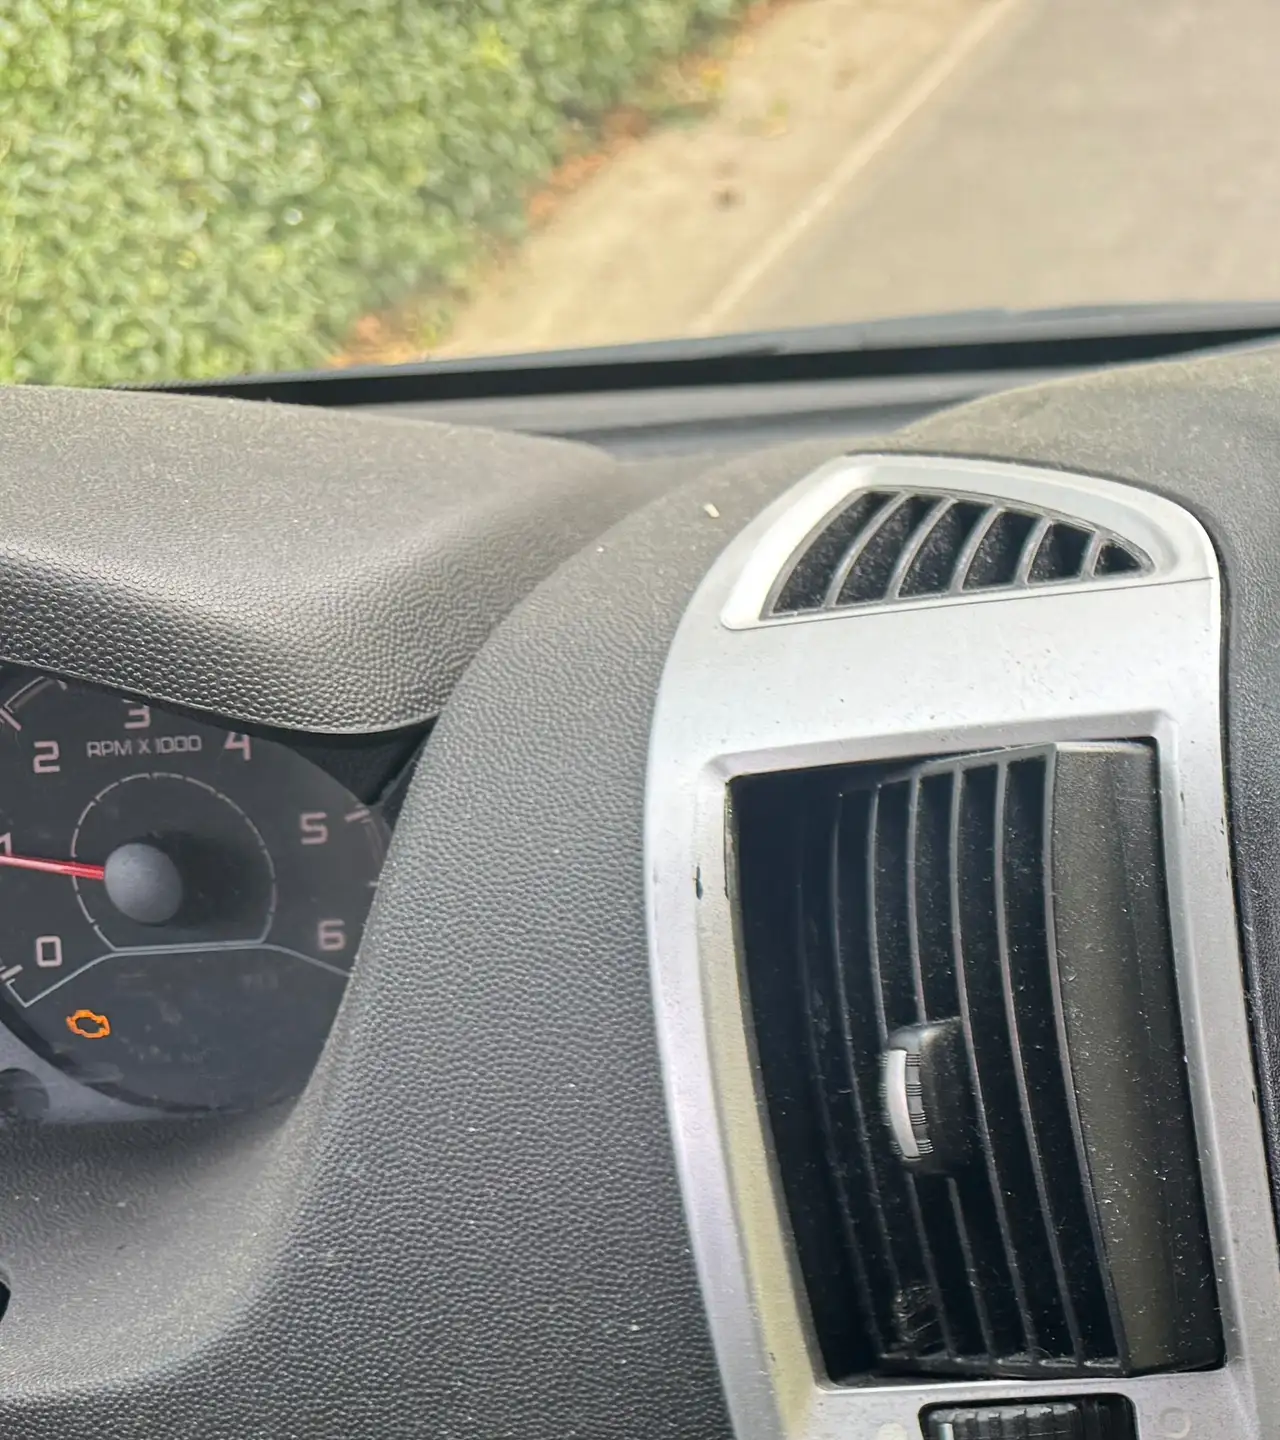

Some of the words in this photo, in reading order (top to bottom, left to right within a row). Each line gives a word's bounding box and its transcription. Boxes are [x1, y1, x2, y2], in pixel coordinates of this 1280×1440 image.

[33, 740, 61, 774] 2
[86, 740, 133, 758] RPM
[138, 739, 151, 755] X
[155, 735, 203, 754] 1000
[224, 731, 252, 761] 4
[300, 812, 328, 845] 5
[35, 935, 62, 968] 0
[317, 919, 345, 952] 6
